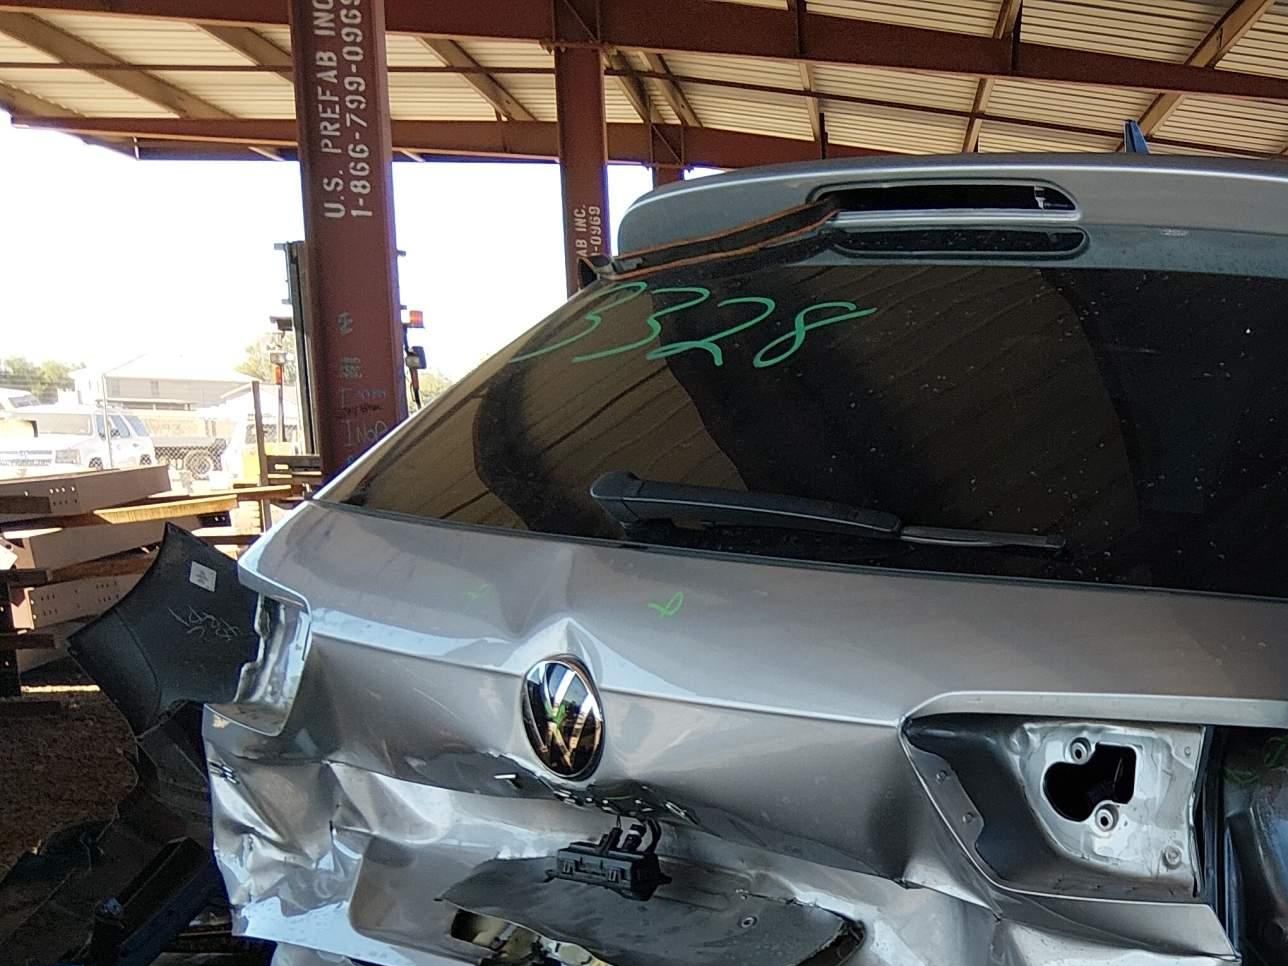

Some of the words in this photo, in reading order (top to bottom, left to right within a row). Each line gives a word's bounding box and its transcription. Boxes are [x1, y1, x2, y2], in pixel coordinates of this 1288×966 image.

[315, 51, 342, 154] PREFAB
[322, 169, 346, 218] U.S.
[574, 203, 588, 232] INC.
[510, 280, 878, 369] 3328
